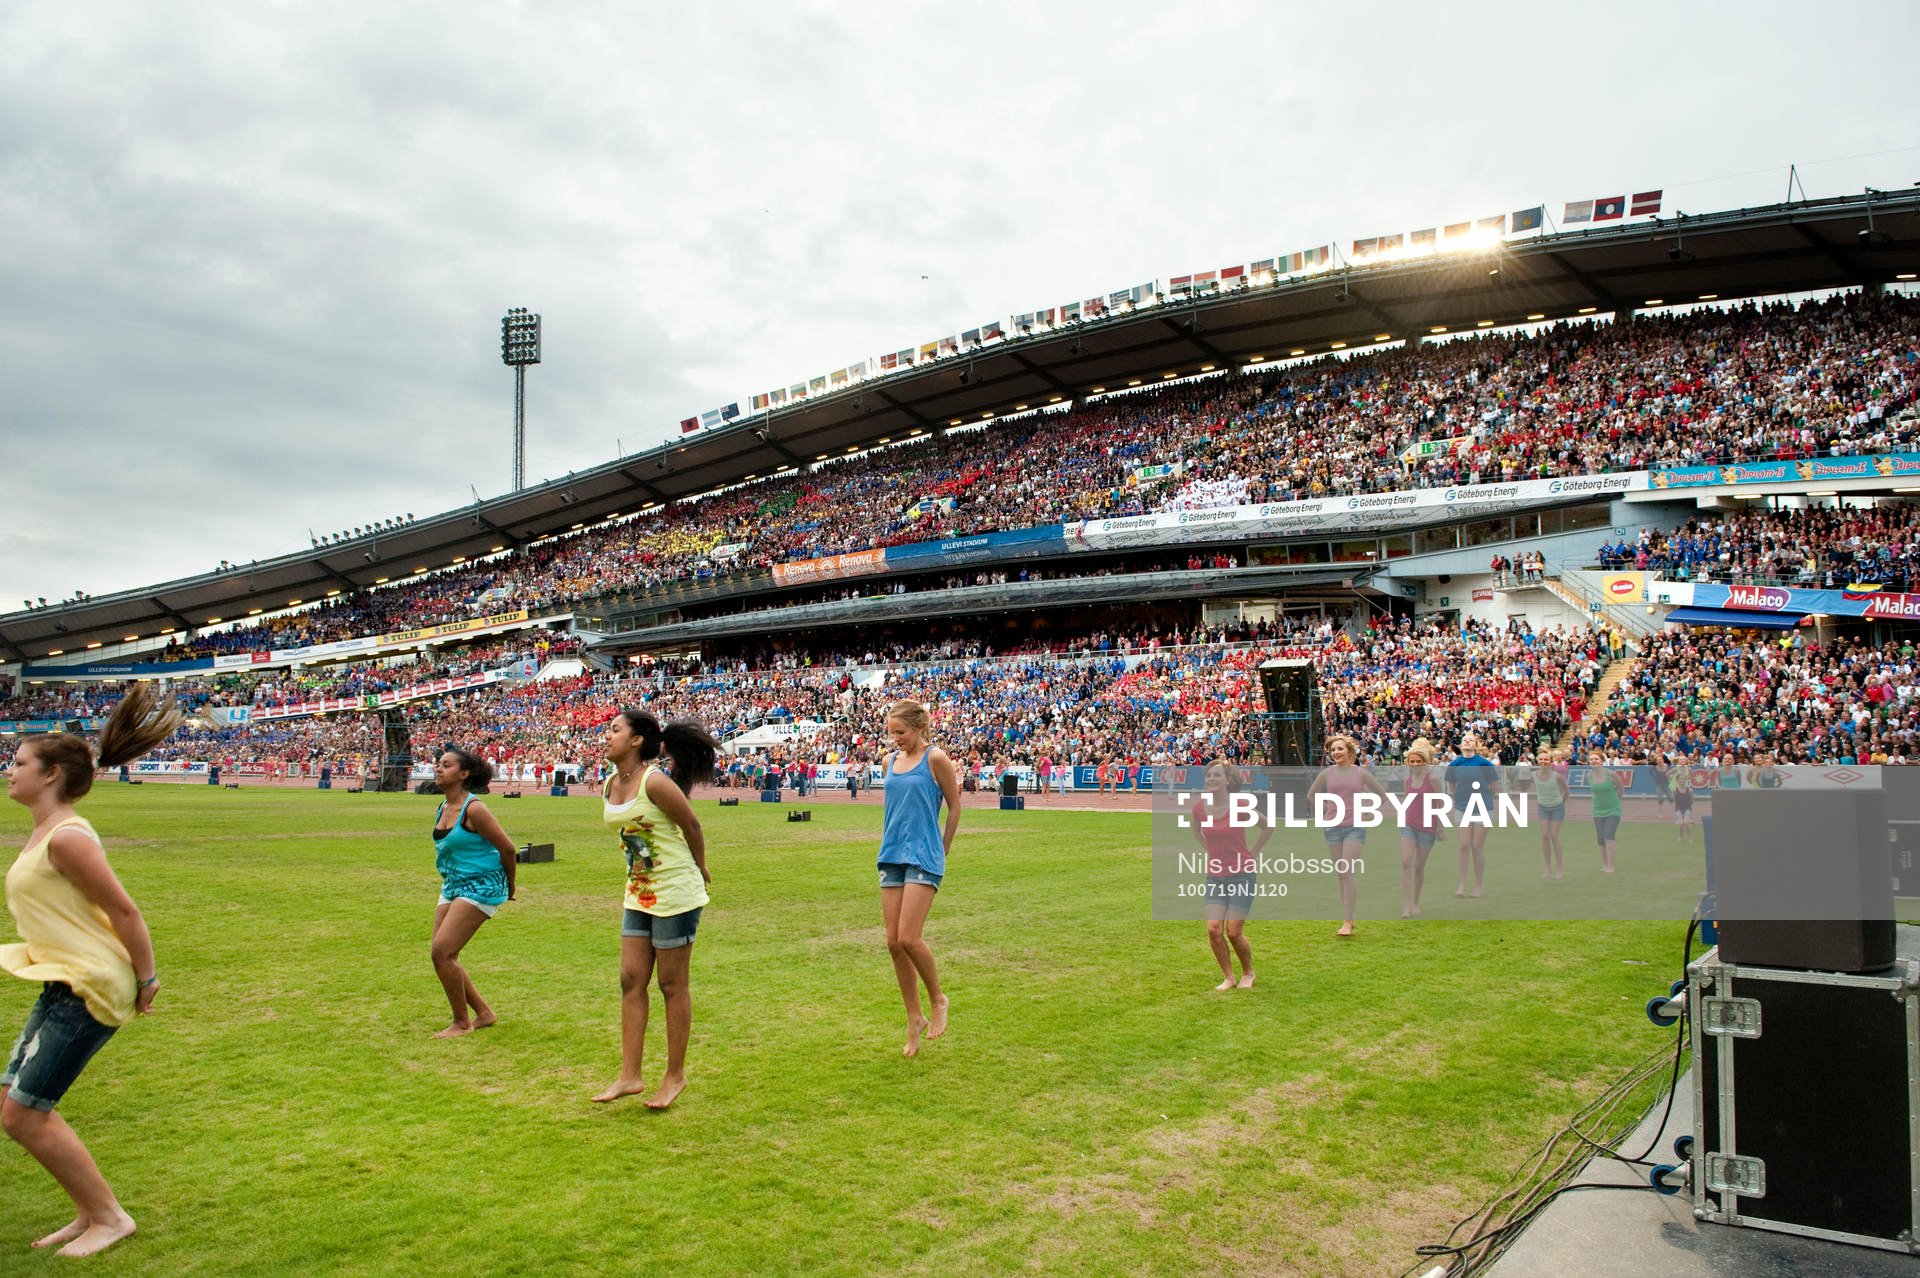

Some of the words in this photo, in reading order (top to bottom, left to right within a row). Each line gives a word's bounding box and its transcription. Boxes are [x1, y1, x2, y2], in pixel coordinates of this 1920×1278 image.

[1562, 480, 1602, 491] Göteborg
[1603, 476, 1631, 488] Energi
[1457, 489, 1493, 500] Göteborg
[1493, 485, 1519, 497] Energi
[1359, 497, 1393, 508] Göteborg
[1393, 494, 1417, 505] Energi
[1270, 505, 1301, 515] Göteborg
[1301, 502, 1323, 513] Energi
[1188, 512, 1217, 522] Göteborg
[1217, 510, 1237, 520] Energi
[1112, 520, 1138, 530] Göteborg
[1138, 518, 1157, 528] Energi
[941, 540, 963, 550] ULLEVI
[962, 538, 988, 547] STADIUM
[783, 562, 815, 574] Renova
[839, 553, 872, 567] Renova
[1733, 587, 1784, 607] Malaco
[490, 613, 520, 624] TULIP
[441, 622, 470, 633] TULIP
[391, 631, 421, 642] TULIP
